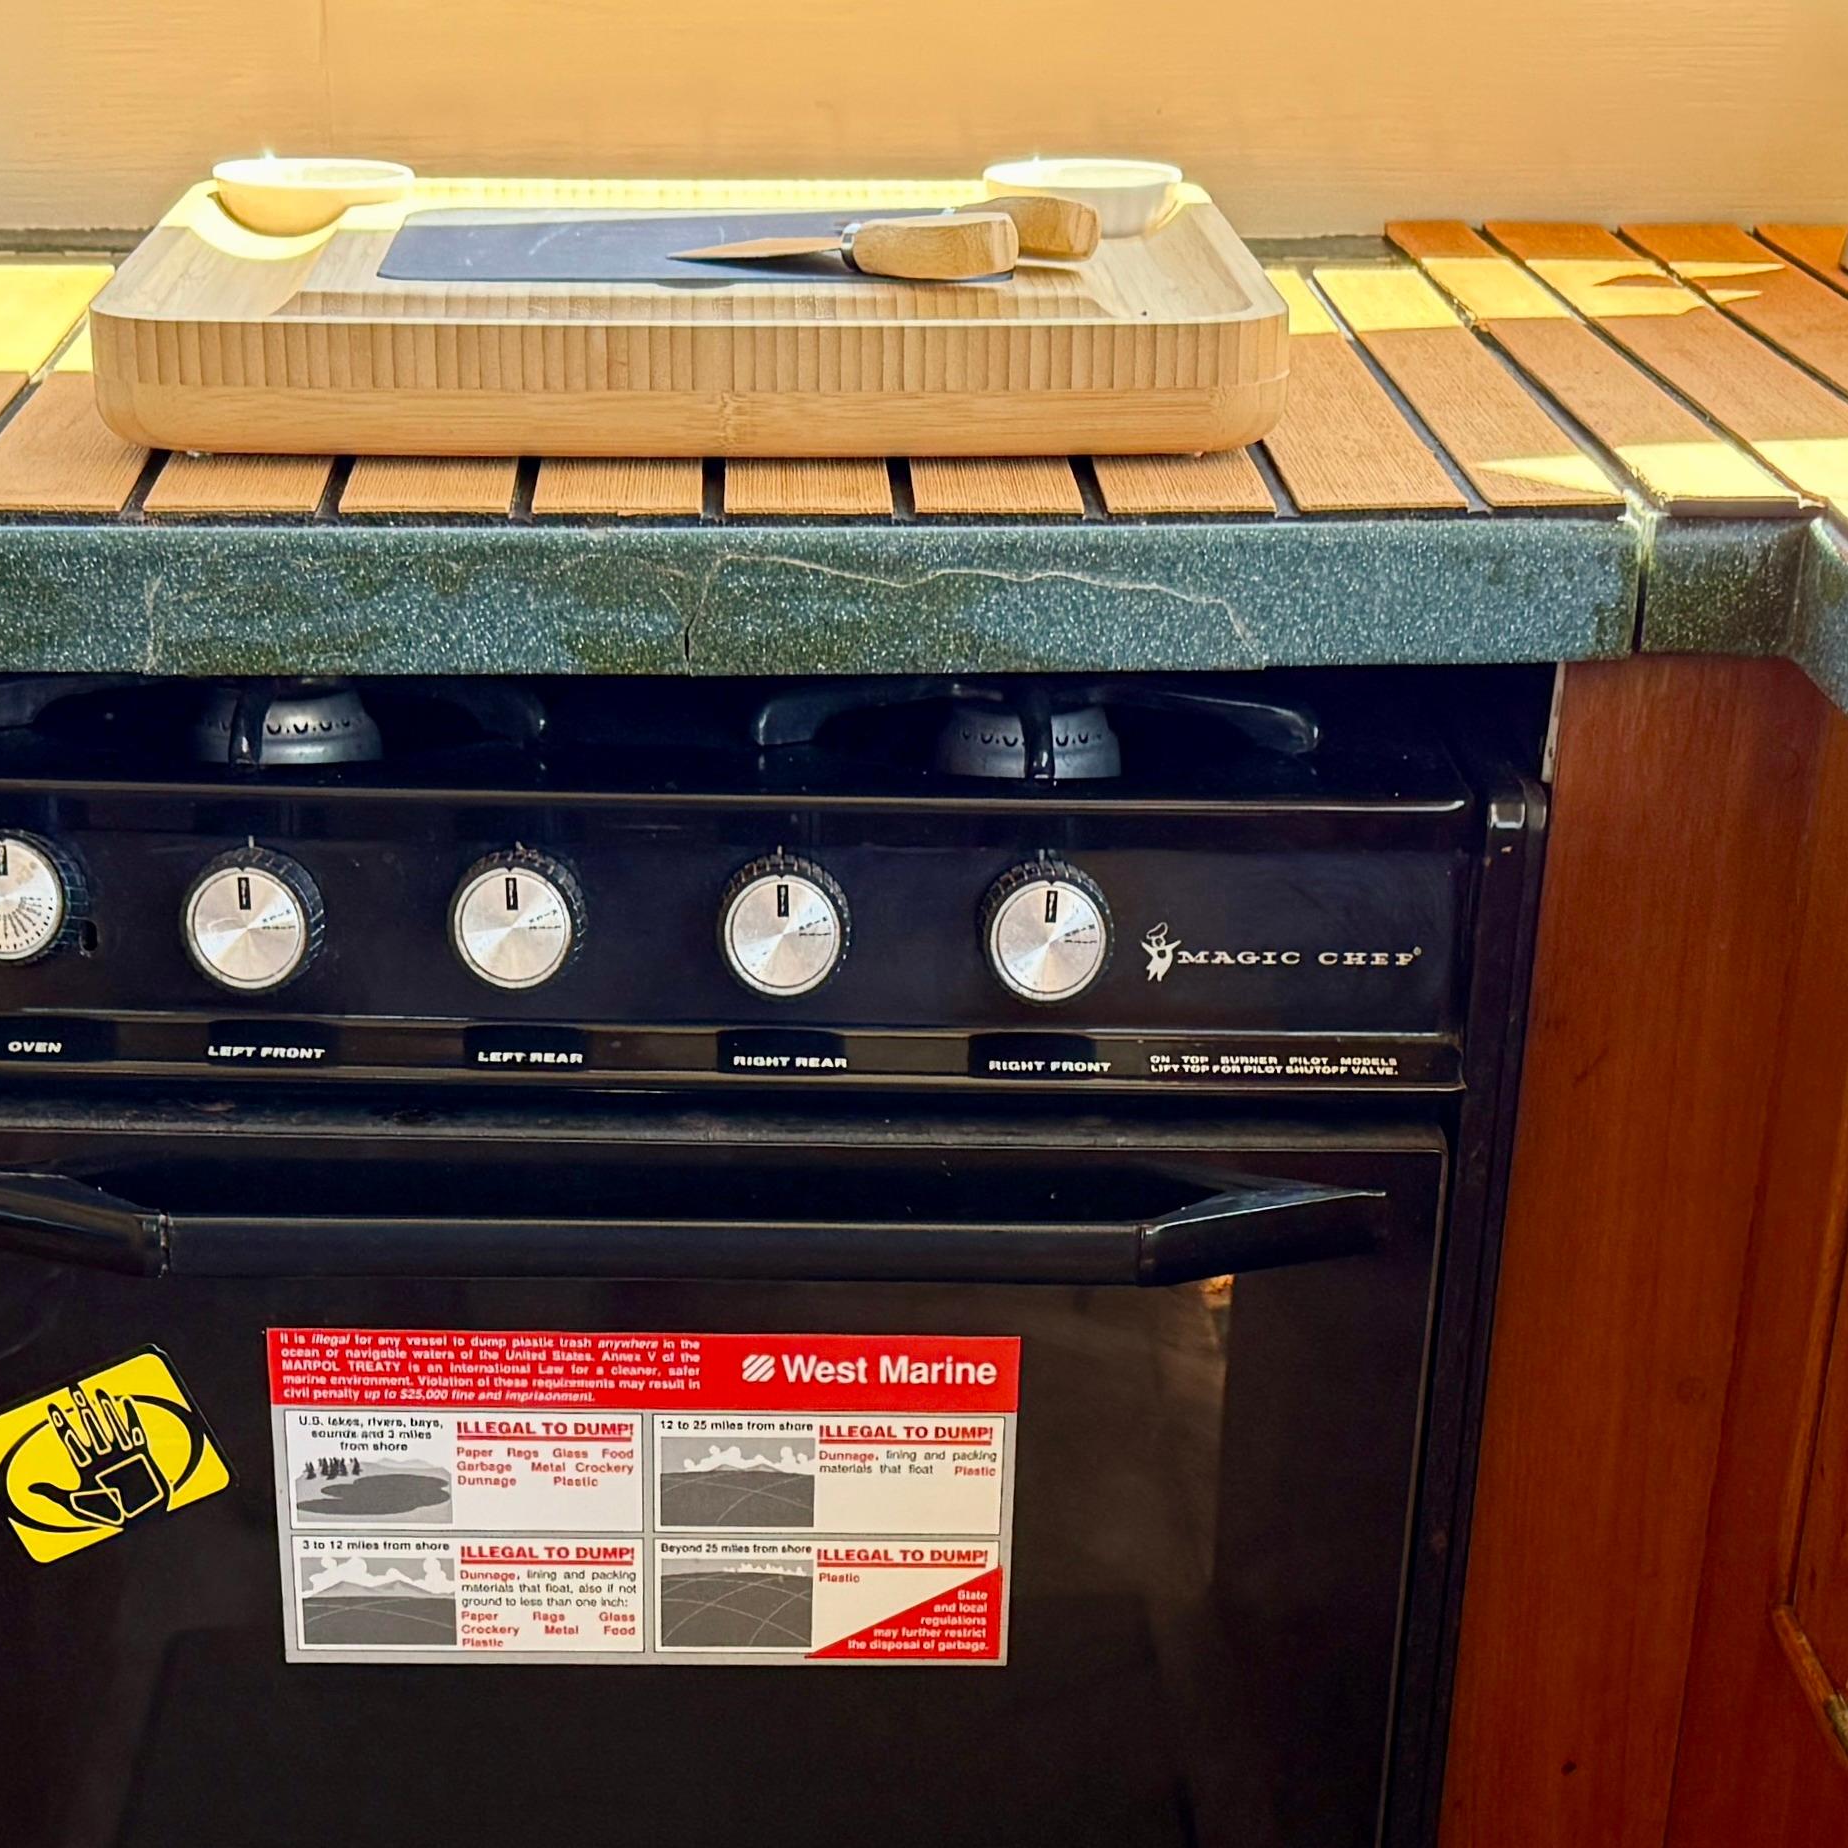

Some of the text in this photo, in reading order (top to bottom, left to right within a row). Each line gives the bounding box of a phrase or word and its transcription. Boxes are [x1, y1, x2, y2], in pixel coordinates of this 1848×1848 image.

[1178, 951, 1414, 966] MAGIC CHEF
[8, 1041, 62, 1053] OVEN
[208, 1046, 325, 1059] LEFT FRONT
[478, 1051, 583, 1064] LEFT REAR
[733, 1056, 848, 1068] RIGHT REAR
[1150, 1055, 1170, 1064] ON
[1182, 1056, 1208, 1064] TOP
[989, 1061, 1111, 1072] RIGHT FRONT
[1183, 1065, 1209, 1073] TOP
[1212, 1065, 1240, 1073] FOR
[1243, 1065, 1283, 1074] PILOT
[782, 1354, 997, 1385] West Marine
[457, 1421, 634, 1435] ILLEGAL TO DUMP!
[661, 1421, 813, 1431] 12 to 25 miles from shore
[819, 1425, 993, 1439] ILLEGAL TO DUMP!
[340, 1442, 368, 1450] from
[457, 1447, 633, 1460] Paper Rags Glass Food
[886, 1451, 916, 1462] lining
[924, 1451, 945, 1459] and
[953, 1451, 996, 1462] packing
[457, 1462, 633, 1474] Garbage Metal Crockery
[819, 1464, 995, 1476] materials that float Plastic
[458, 1475, 598, 1488] Dunnage Plastic
[303, 1540, 449, 1550] 3 to 12 miles from shore
[661, 1543, 811, 1555] Beyond 25 miles from shore
[461, 1546, 634, 1560] ILLEGAL TO DUMP!
[817, 1549, 988, 1562] ILLEGAL TO DUMP!
[527, 1570, 556, 1582] lining
[564, 1571, 585, 1579] and
[592, 1571, 636, 1582] packing
[819, 1573, 860, 1582] Plastic
[462, 1583, 513, 1592] materials
[520, 1583, 540, 1592] that
[579, 1584, 601, 1592] also
[619, 1584, 636, 1593] not
[462, 1597, 501, 1607] ground
[506, 1598, 516, 1606] to
[520, 1598, 543, 1606] less
[547, 1598, 572, 1606] than
[576, 1599, 596, 1607] one
[934, 1603, 987, 1613] and local
[462, 1611, 635, 1622] Paper Rags Glass
[921, 1616, 986, 1626] regulations
[462, 1625, 635, 1635] Crockery Metal Food
[874, 1627, 986, 1638] may further restrict
[463, 1638, 503, 1647] Plastic
[848, 1640, 866, 1649] the
[870, 1640, 923, 1651] disposal
[927, 1640, 935, 1649] of
